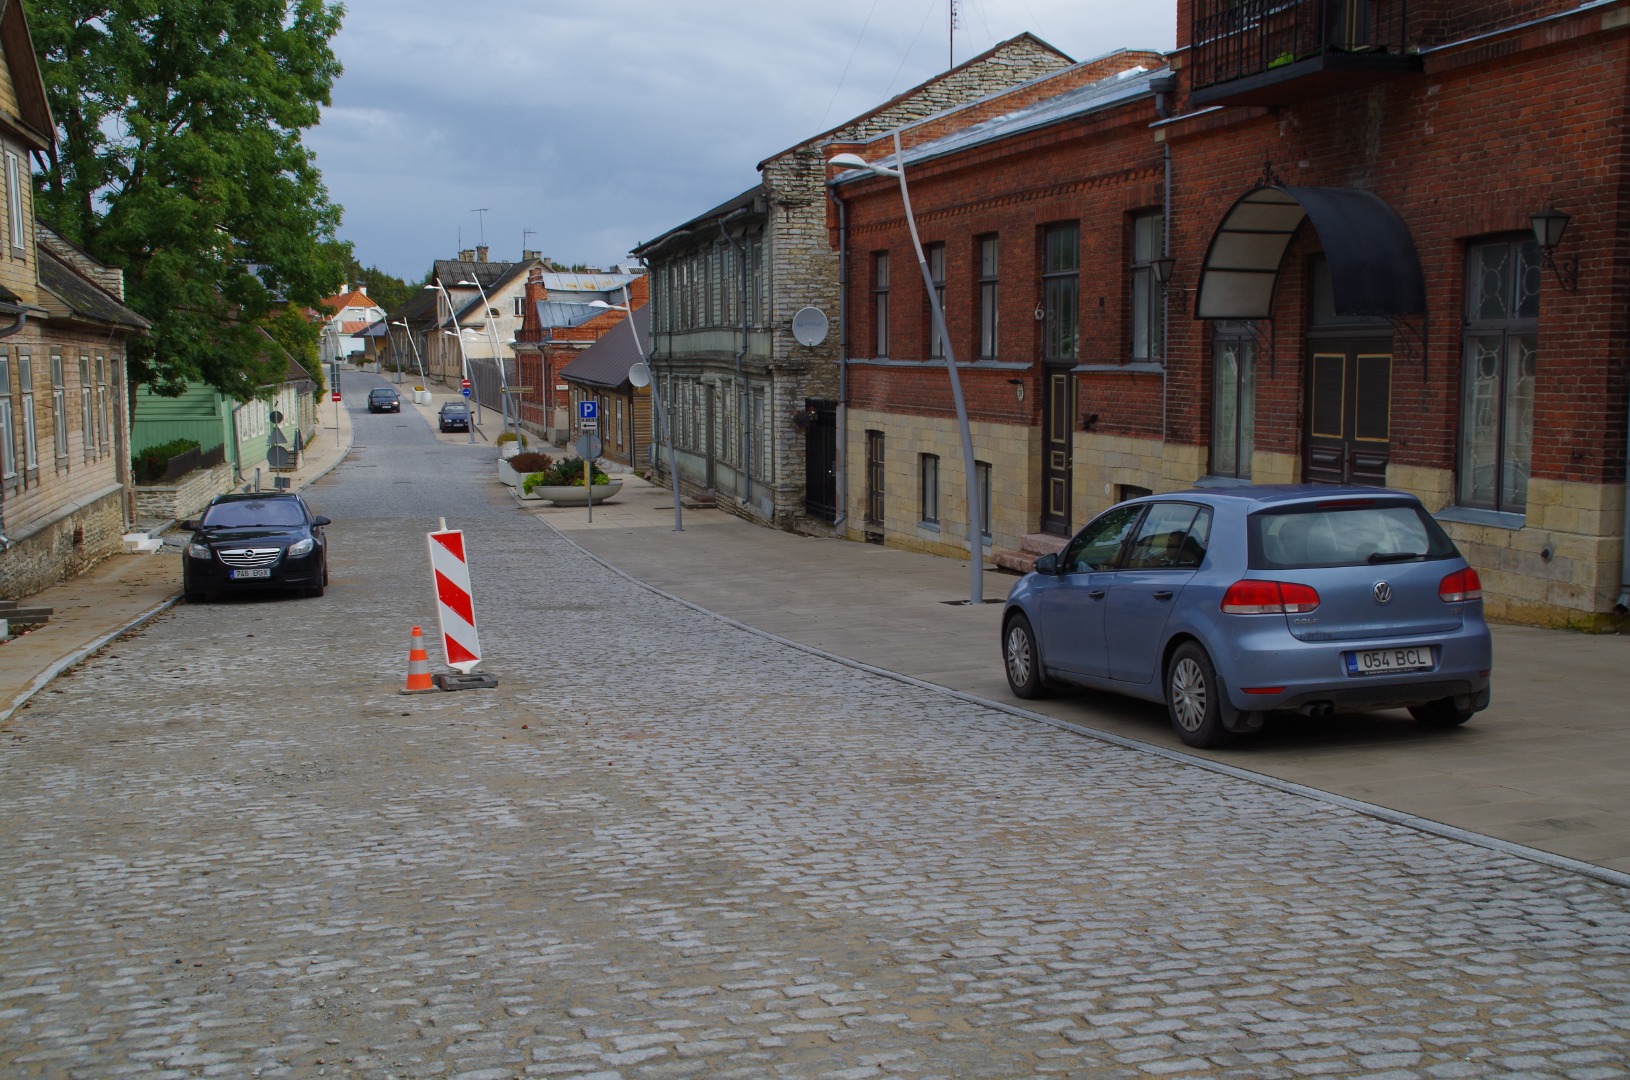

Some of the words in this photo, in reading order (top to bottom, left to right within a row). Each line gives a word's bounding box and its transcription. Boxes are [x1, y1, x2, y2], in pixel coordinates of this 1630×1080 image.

[584, 403, 593, 417] P
[1363, 651, 1390, 668] 054
[1395, 649, 1426, 666] BCL
